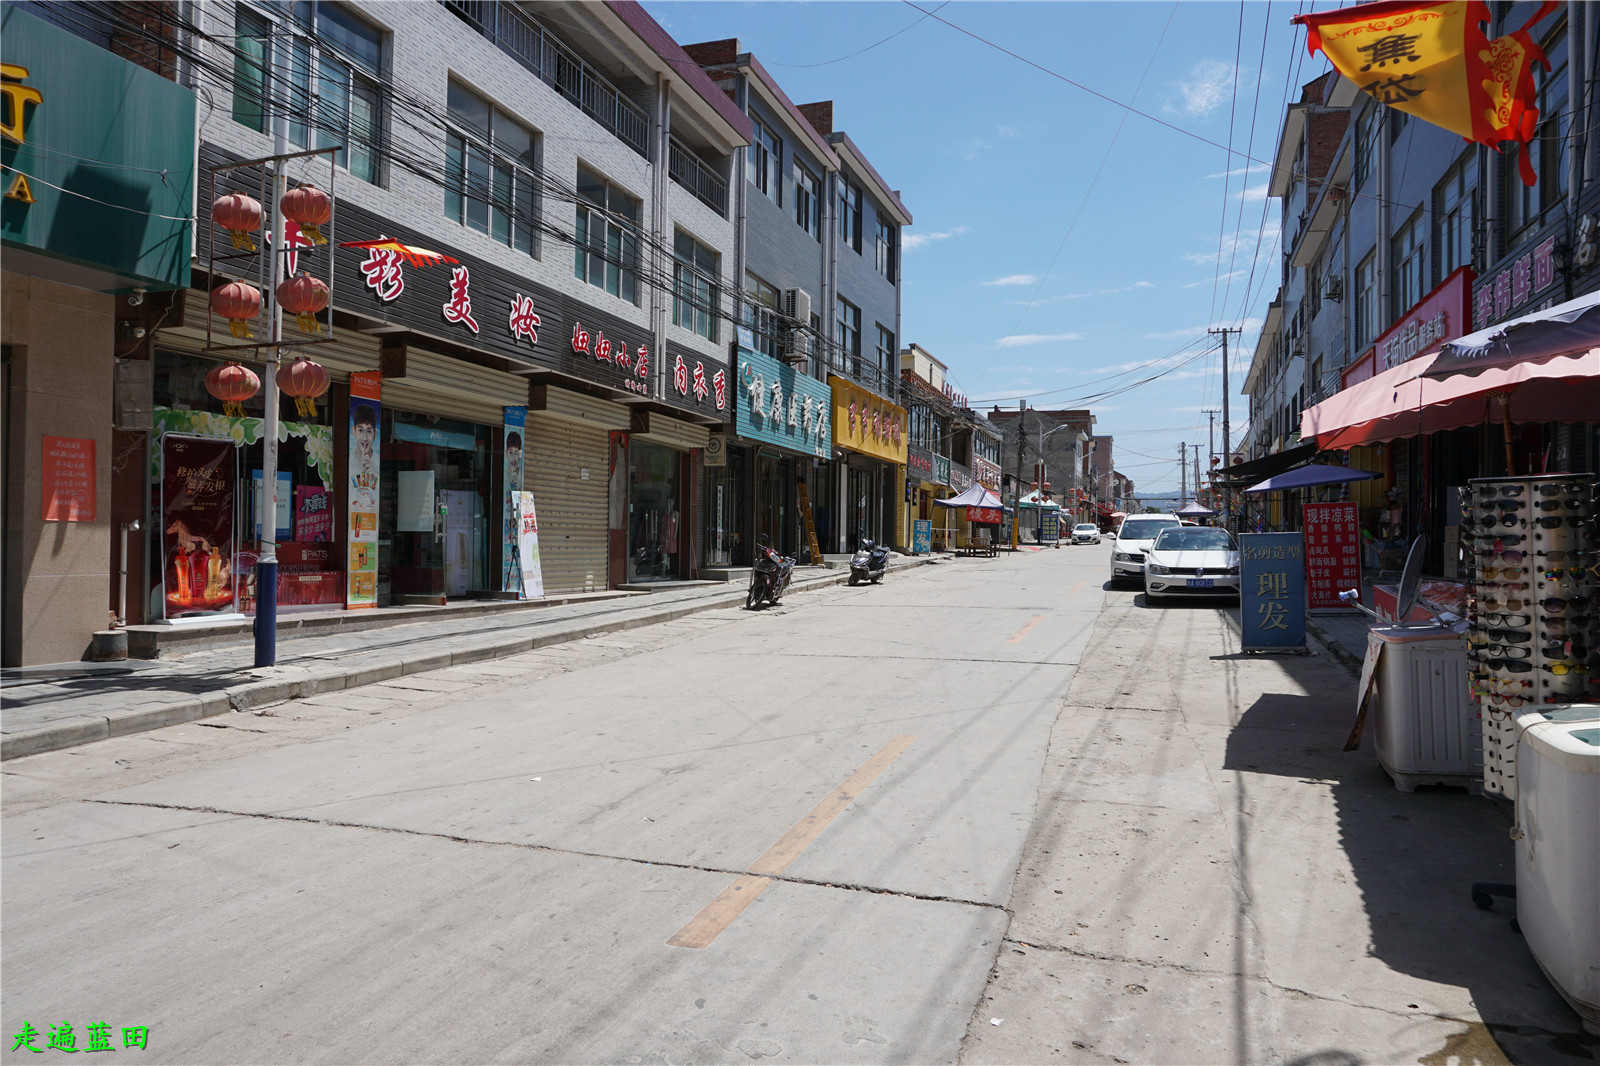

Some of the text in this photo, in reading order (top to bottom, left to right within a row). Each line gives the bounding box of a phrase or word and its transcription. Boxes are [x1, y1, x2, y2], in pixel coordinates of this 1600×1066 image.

[1476, 235, 1555, 329] 李伟鲜面
[571, 321, 650, 379] 妞妞小店
[673, 354, 727, 411] 内衣秀
[968, 507, 1000, 522] 馒头
[1306, 506, 1356, 524] 现拌凉菜
[1243, 544, 1302, 561] 名剪造型
[1257, 572, 1290, 631] 理发
